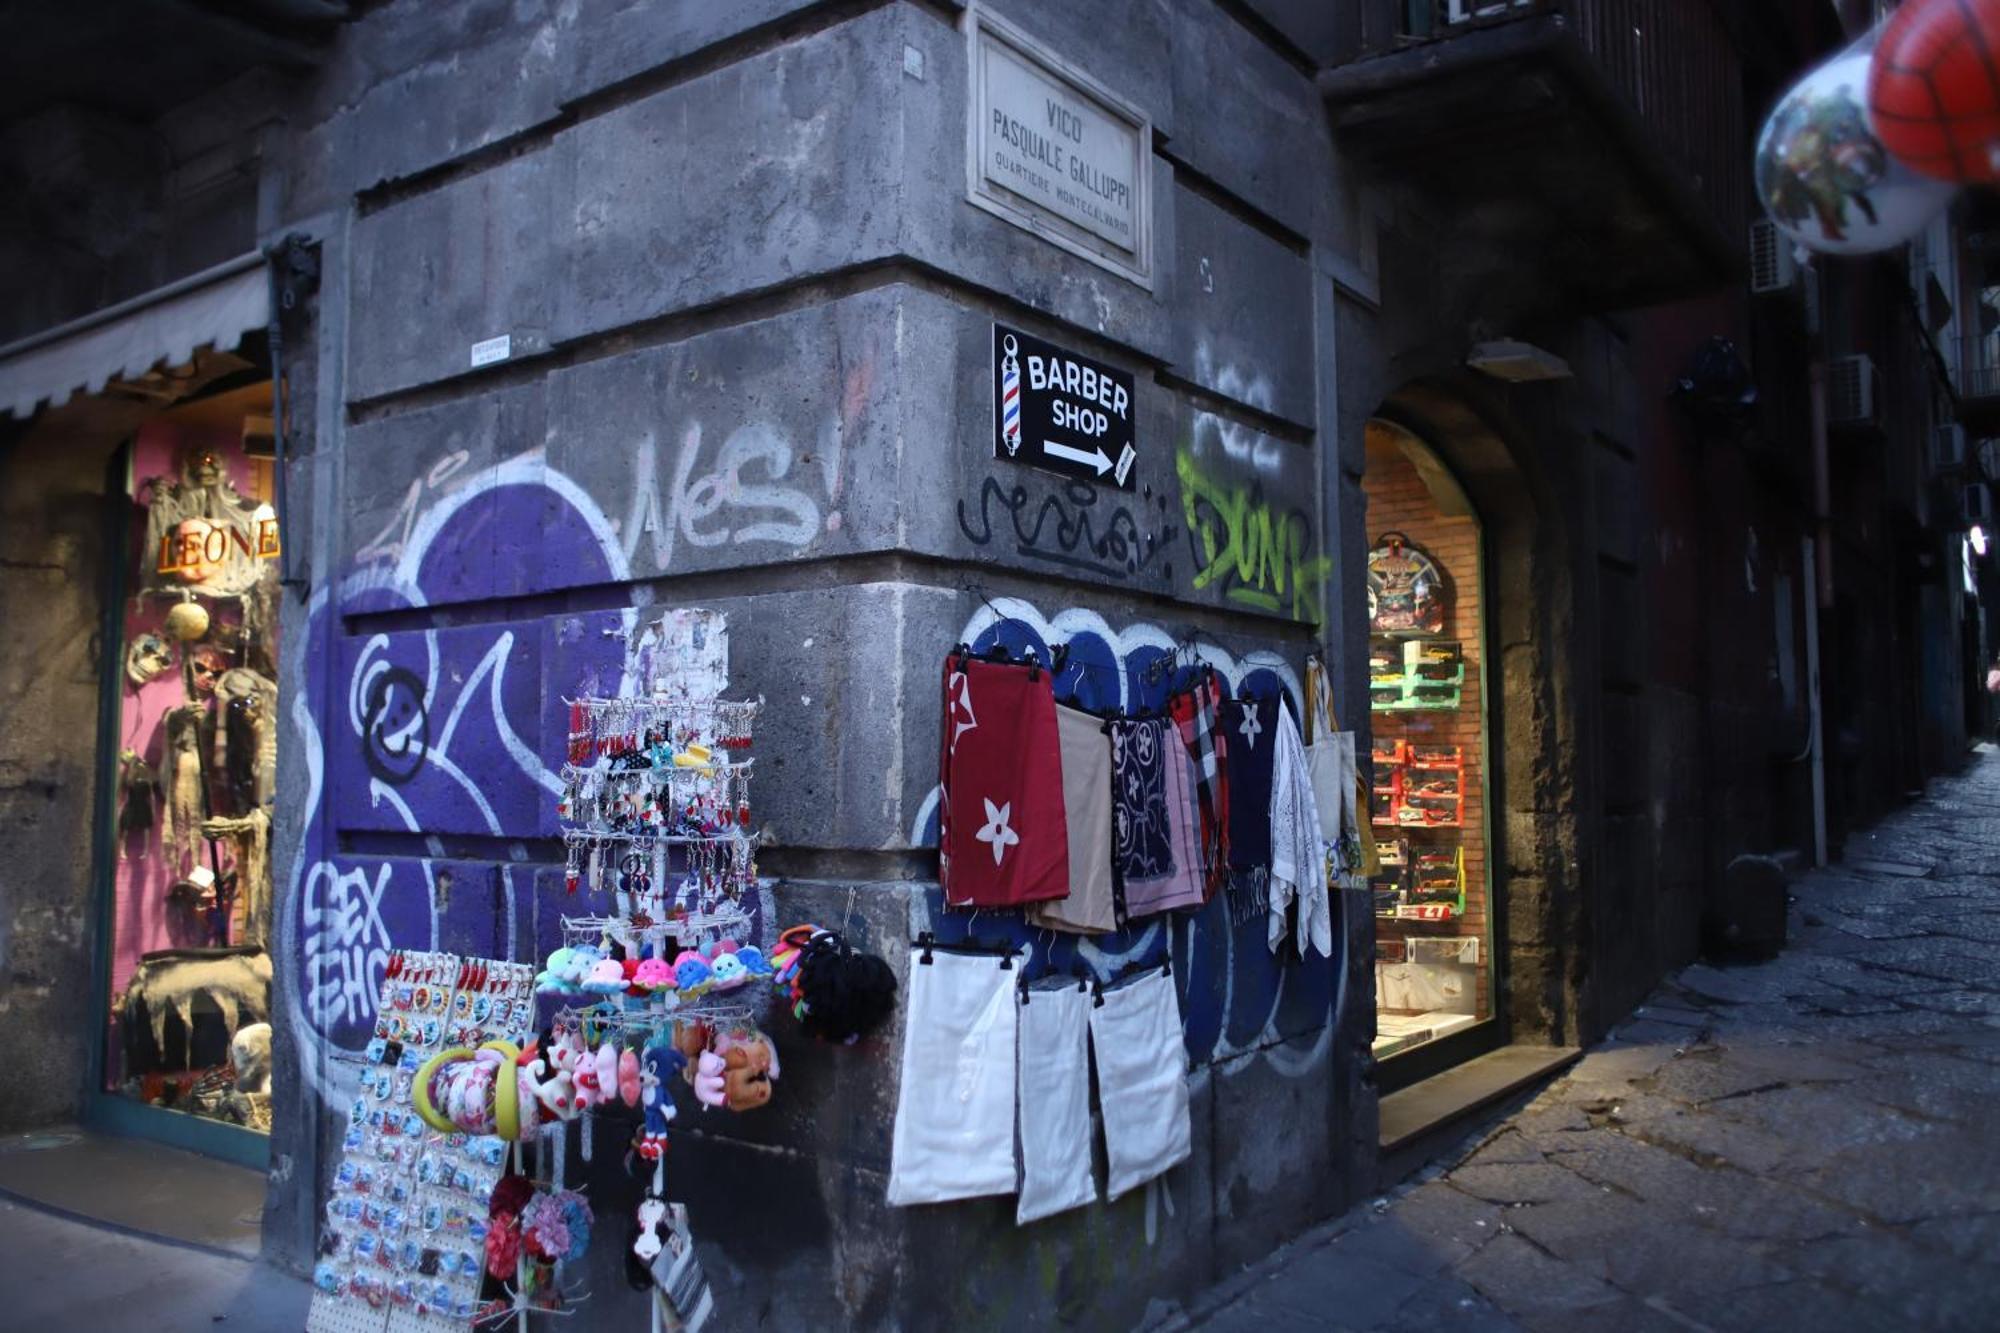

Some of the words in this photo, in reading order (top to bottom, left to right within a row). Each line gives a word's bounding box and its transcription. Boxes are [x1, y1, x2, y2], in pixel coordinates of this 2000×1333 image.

[1046, 98, 1082, 144] VICO
[993, 108, 1063, 173] PASQUALE
[1070, 155, 1130, 211] GALLUPPI
[995, 151, 1050, 193] QUARTIERE
[1056, 186, 1129, 236] MONTECALVARIO
[1027, 355, 1129, 420] BARBER
[1052, 400, 1109, 437] SHOP
[157, 517, 281, 573] LEONE
